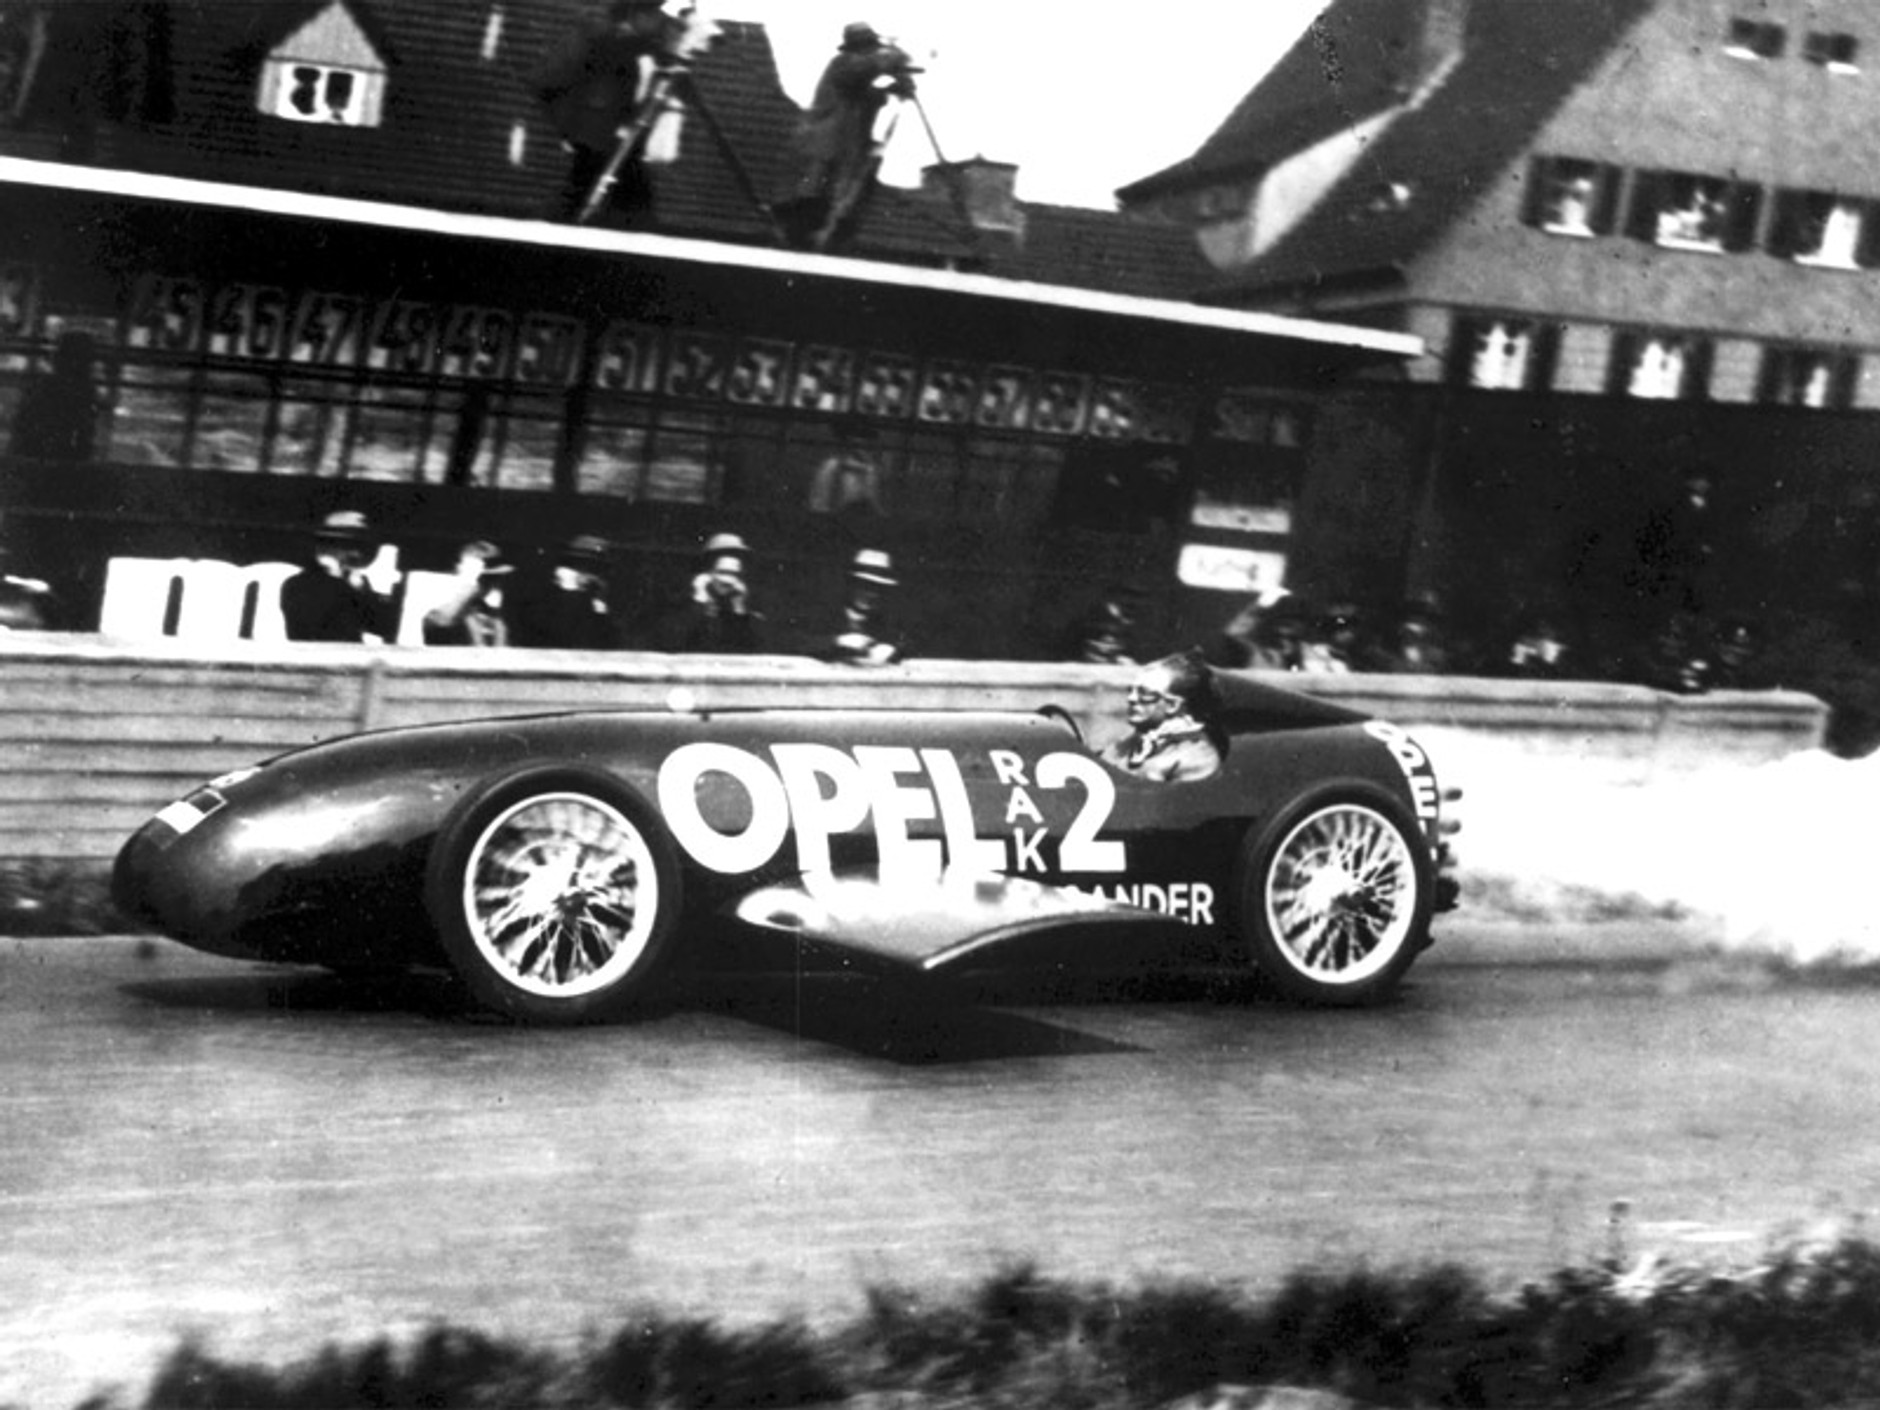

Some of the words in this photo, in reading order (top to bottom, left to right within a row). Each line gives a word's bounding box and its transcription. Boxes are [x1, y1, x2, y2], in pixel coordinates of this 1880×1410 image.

[209, 287, 282, 356] 46
[299, 296, 361, 365] 47
[657, 742, 1007, 873] OPEL
[989, 750, 1047, 872] RAK
[1035, 752, 1127, 872] 2
